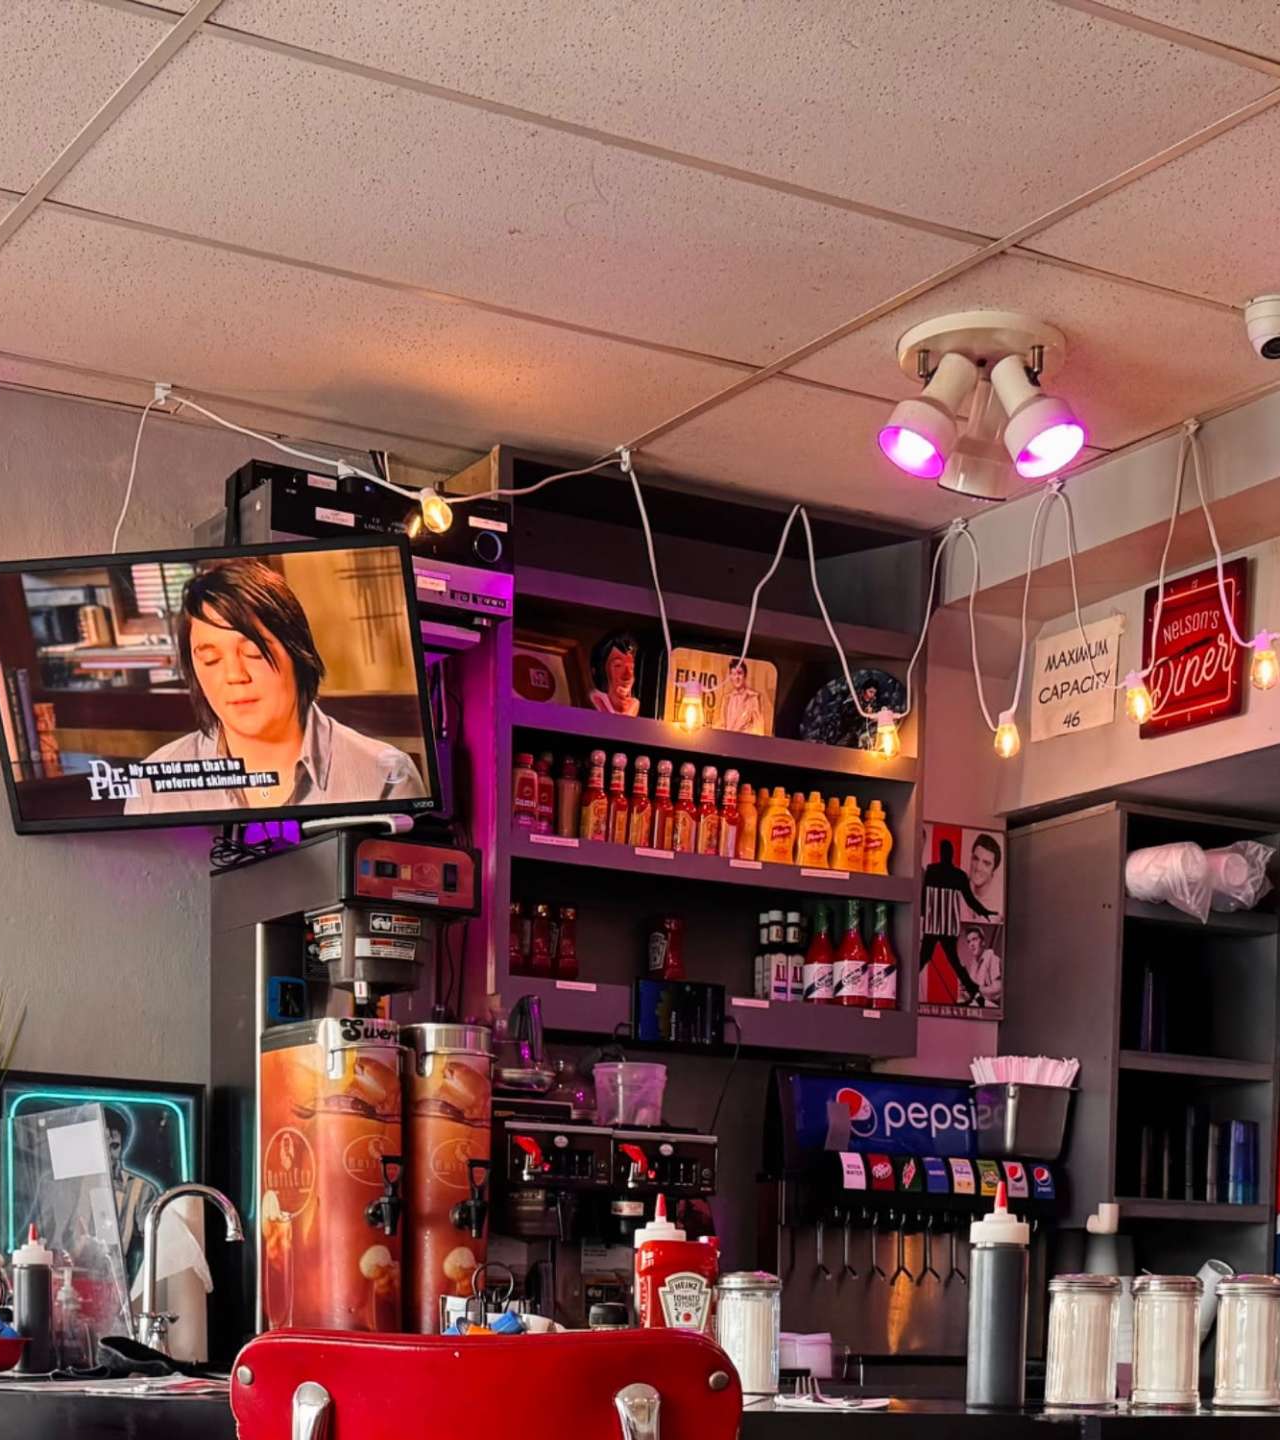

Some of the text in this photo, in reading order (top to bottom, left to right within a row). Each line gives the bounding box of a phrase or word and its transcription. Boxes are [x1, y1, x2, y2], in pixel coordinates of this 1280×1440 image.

[1044, 637, 1109, 673] MAXIMUM
[1150, 633, 1236, 715] Diner
[1038, 670, 1111, 704] CAPACITY
[1062, 712, 1081, 728] 46
[88, 760, 128, 783] Dr.
[129, 759, 240, 777] My ex told me that he
[88, 777, 139, 800] Phil
[154, 772, 276, 791] preferred skinnier girls.
[925, 886, 961, 937] ELVIS
[884, 1098, 977, 1137] pepsi
[675, 1281, 698, 1290] HEINZ
